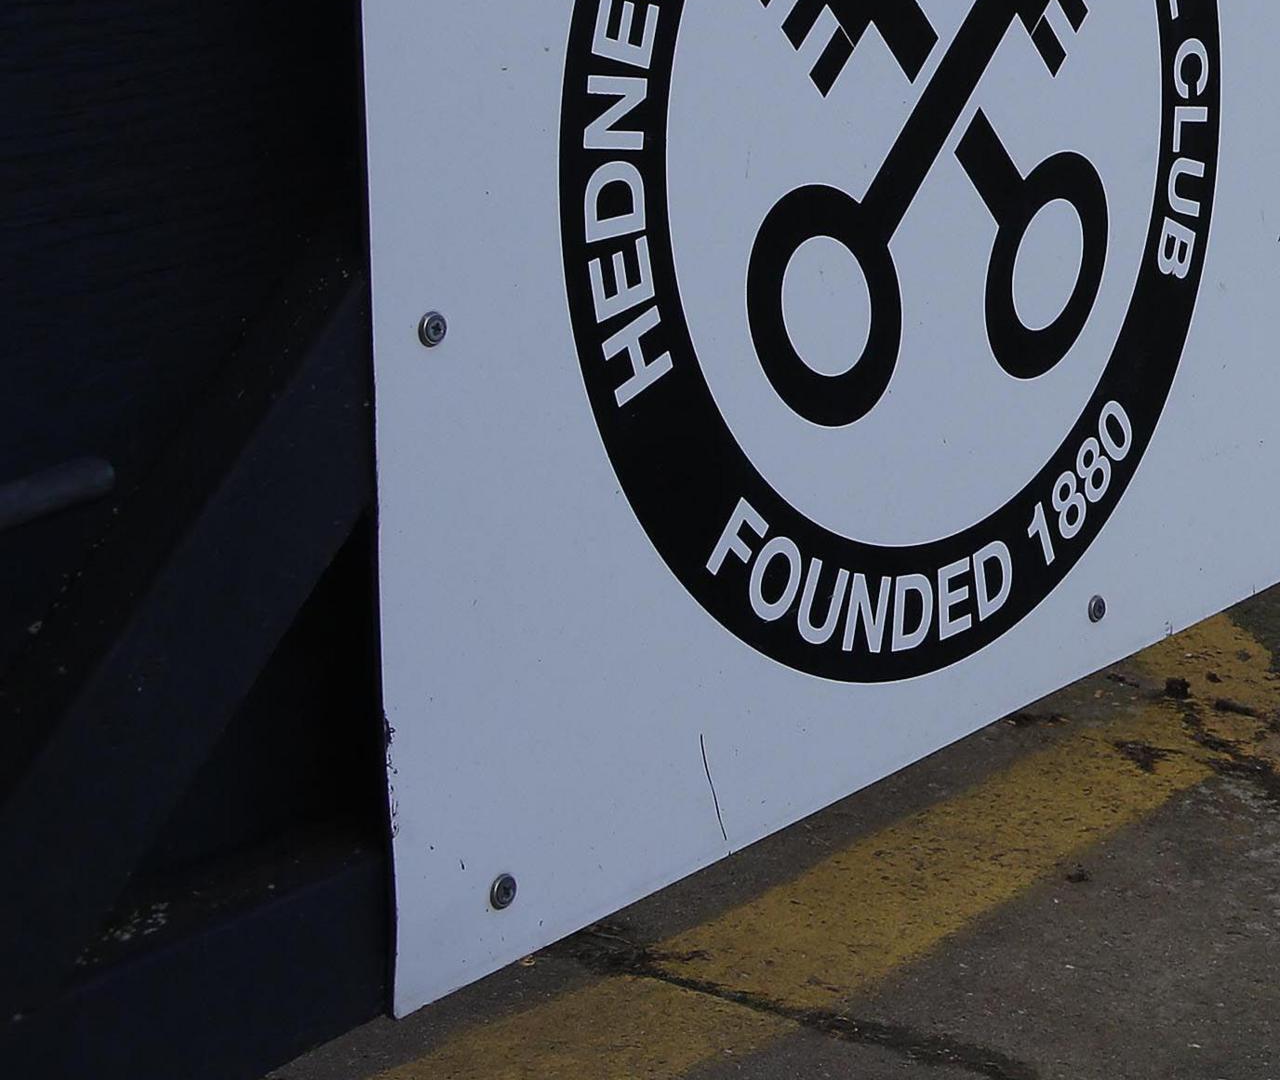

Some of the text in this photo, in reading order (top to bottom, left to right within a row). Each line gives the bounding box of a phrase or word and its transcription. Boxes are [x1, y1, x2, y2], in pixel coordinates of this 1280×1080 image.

[1157, 38, 1209, 280] CLUB
[705, 400, 1133, 653] FOUNDED 1880
